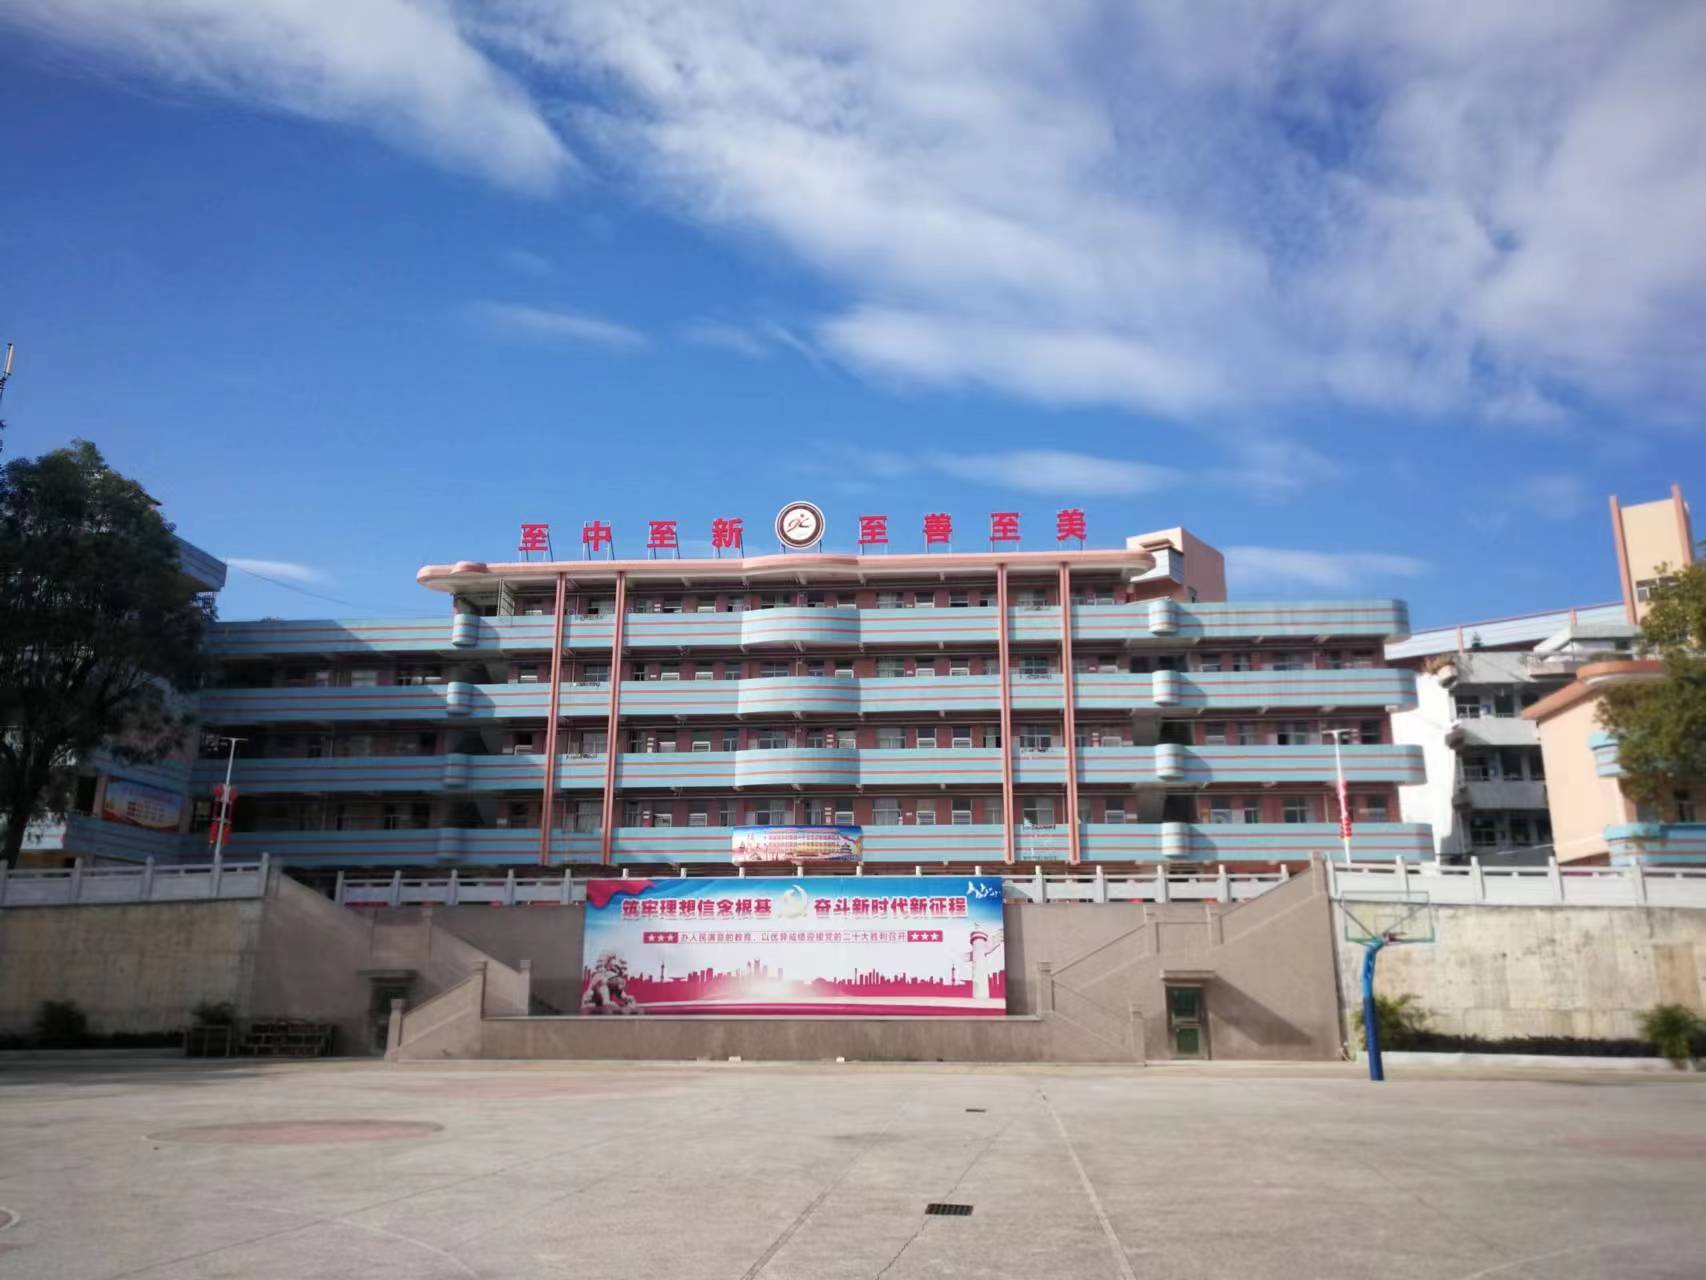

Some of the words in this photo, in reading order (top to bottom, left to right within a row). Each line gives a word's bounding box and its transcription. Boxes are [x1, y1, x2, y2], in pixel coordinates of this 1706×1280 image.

[518, 517, 743, 551] 至中至新
[858, 508, 1087, 544] 至善至美
[622, 898, 772, 916] 筑牢理想信念根基
[814, 897, 967, 914] 奋斗新时代新征程
